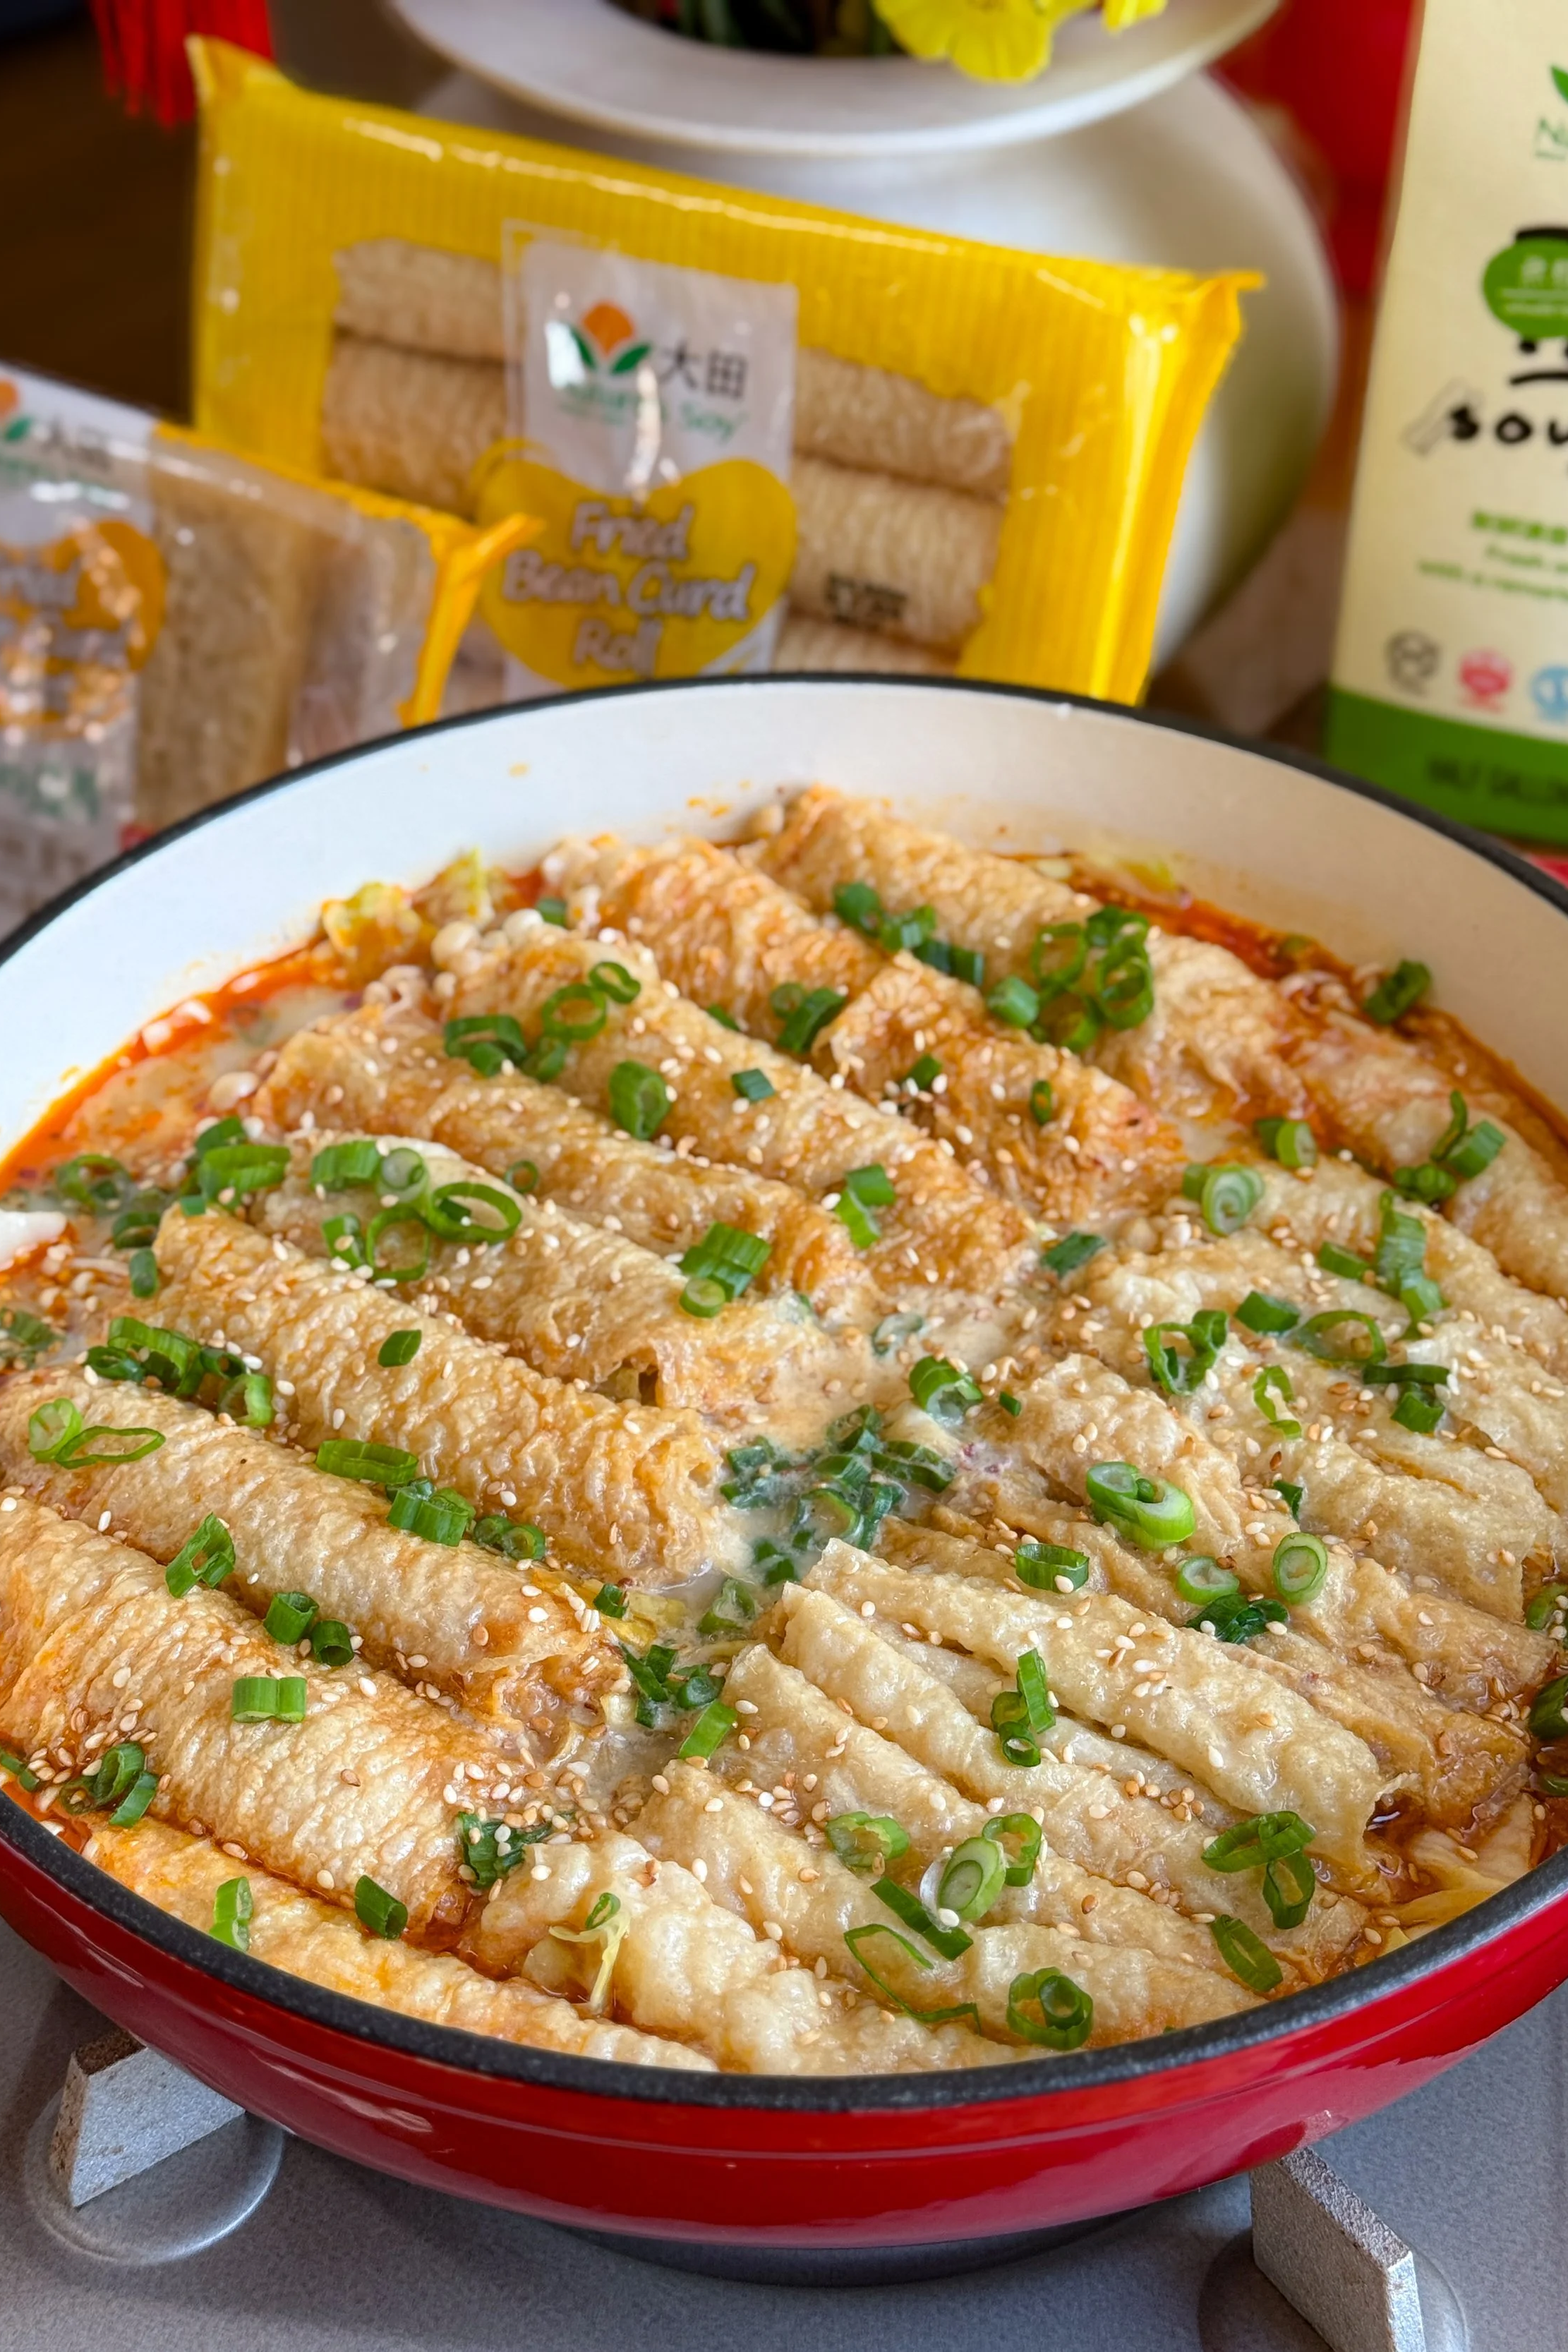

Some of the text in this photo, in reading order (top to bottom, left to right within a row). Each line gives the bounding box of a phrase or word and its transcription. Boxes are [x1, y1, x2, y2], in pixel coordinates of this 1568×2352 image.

[659, 339, 748, 401] 大田
[570, 500, 696, 560] Fried
[502, 549, 622, 607] Bean
[625, 560, 757, 622] Curd
